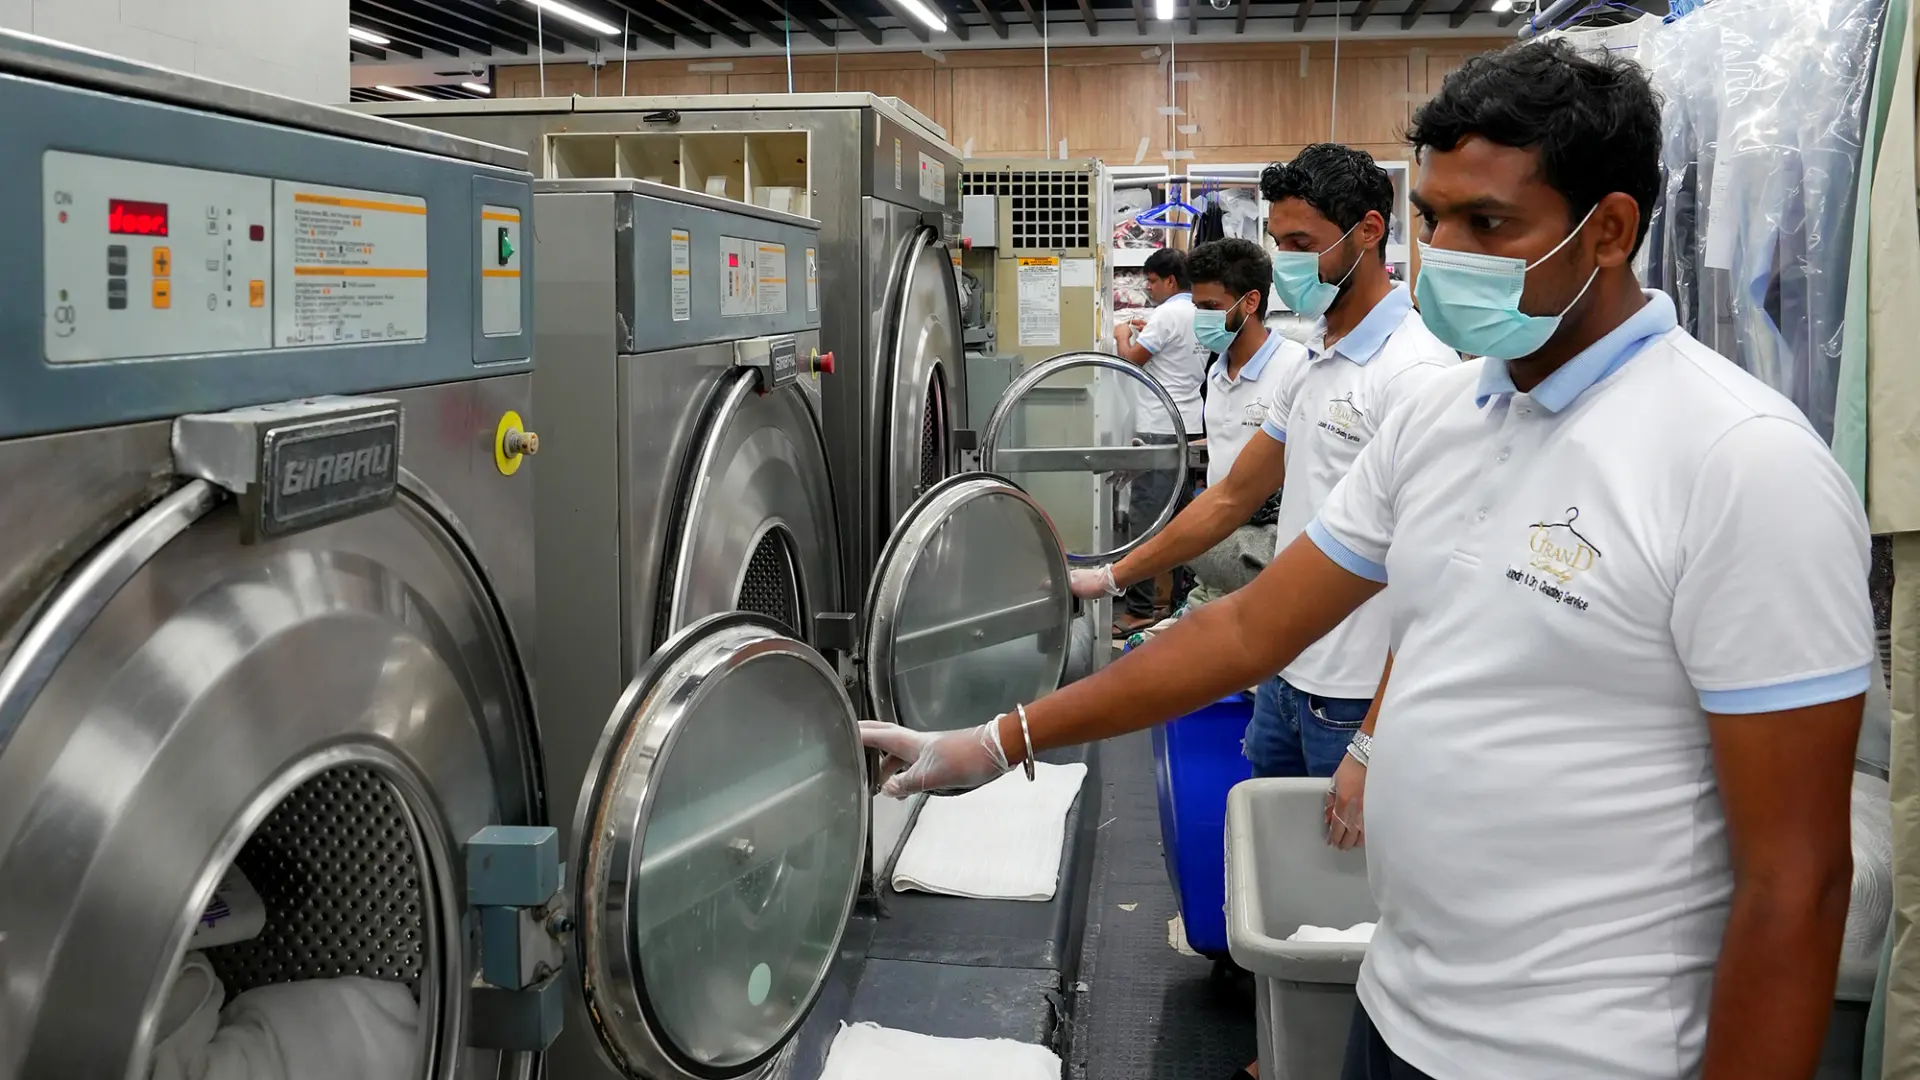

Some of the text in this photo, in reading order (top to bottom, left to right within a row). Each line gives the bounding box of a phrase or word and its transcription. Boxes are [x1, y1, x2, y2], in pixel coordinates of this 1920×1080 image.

[281, 443, 392, 496] GIRBAU
[1530, 528, 1593, 571] GRAND
[1563, 591, 1589, 611] Service
